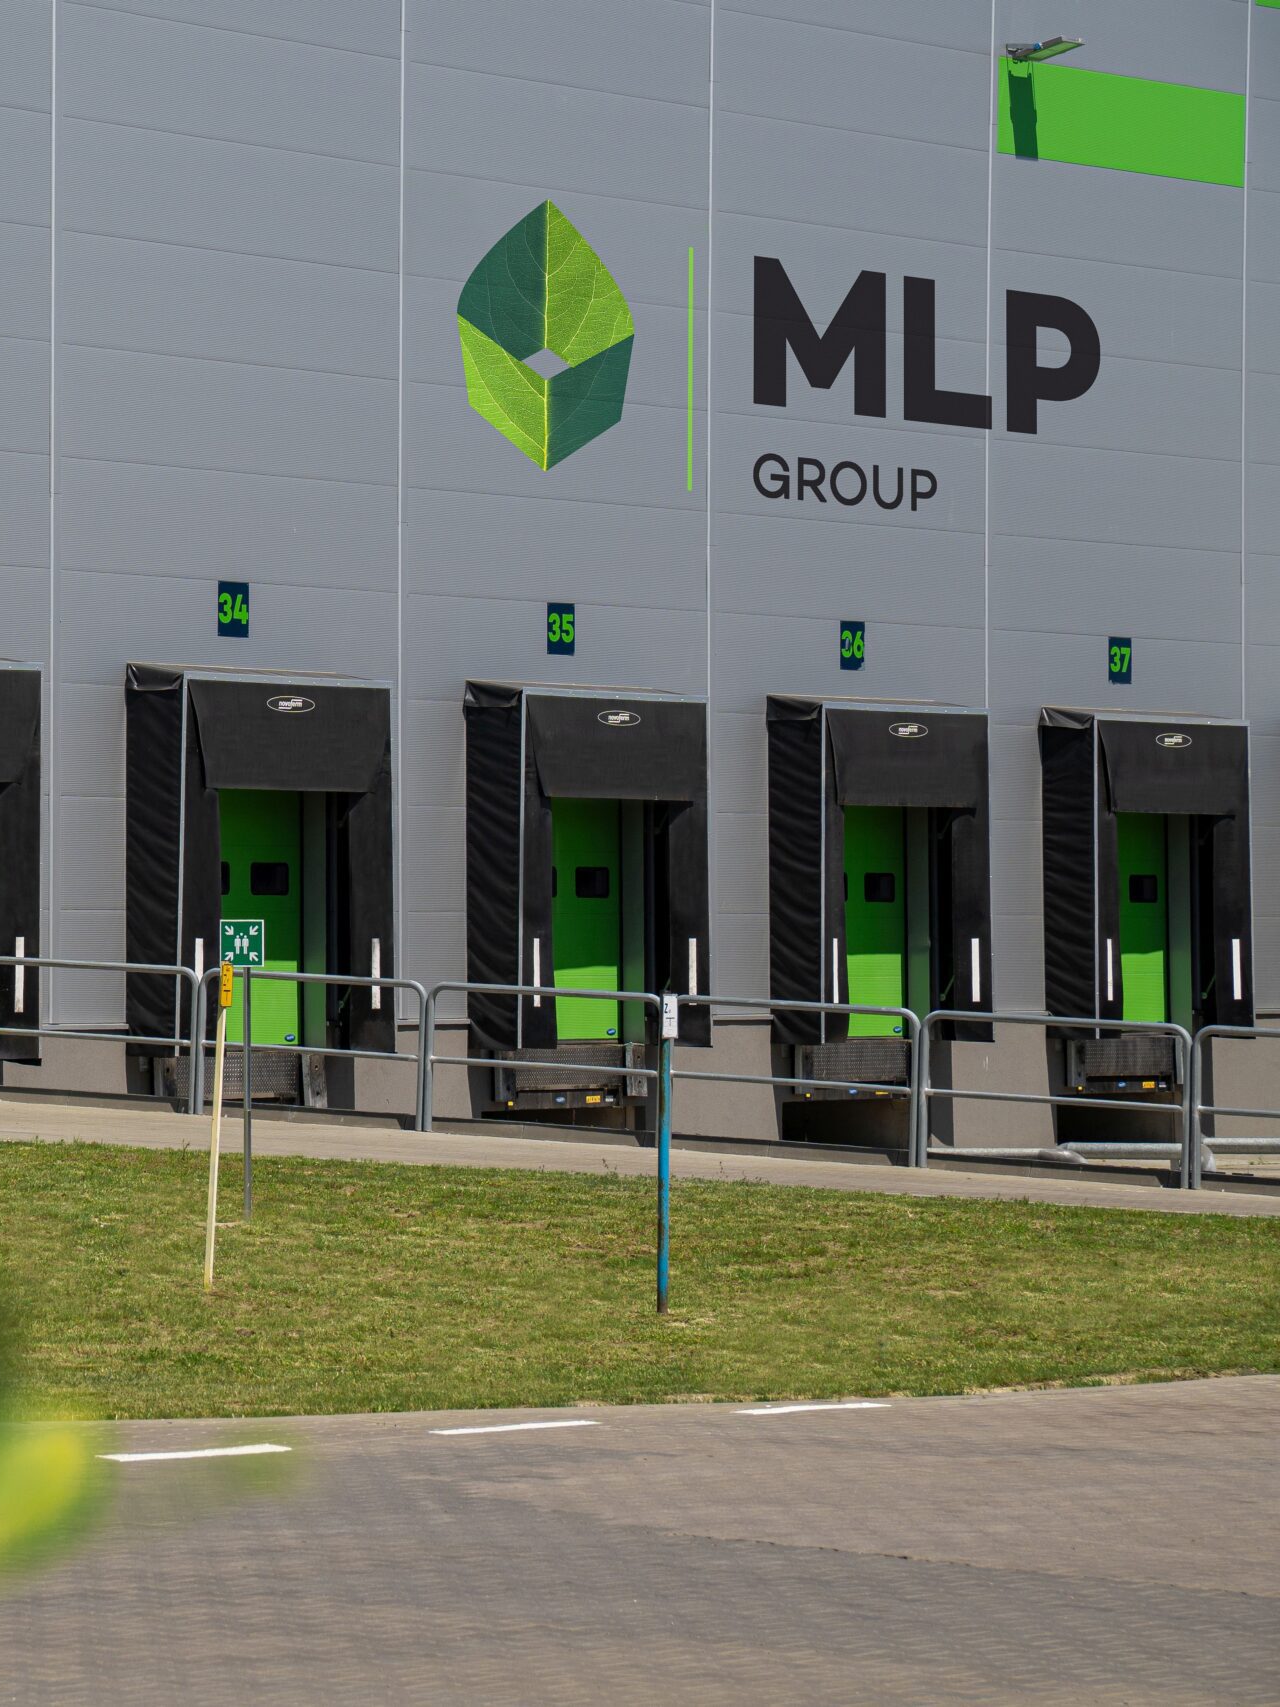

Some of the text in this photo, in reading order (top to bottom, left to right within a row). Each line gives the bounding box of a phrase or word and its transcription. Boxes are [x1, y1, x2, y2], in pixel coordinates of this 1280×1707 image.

[753, 255, 1100, 434] MLP
[753, 453, 937, 511] GROUP
[218, 592, 249, 625] 34
[548, 612, 574, 643] 35
[1110, 646, 1131, 673] 37
[278, 699, 303, 710] novoferm
